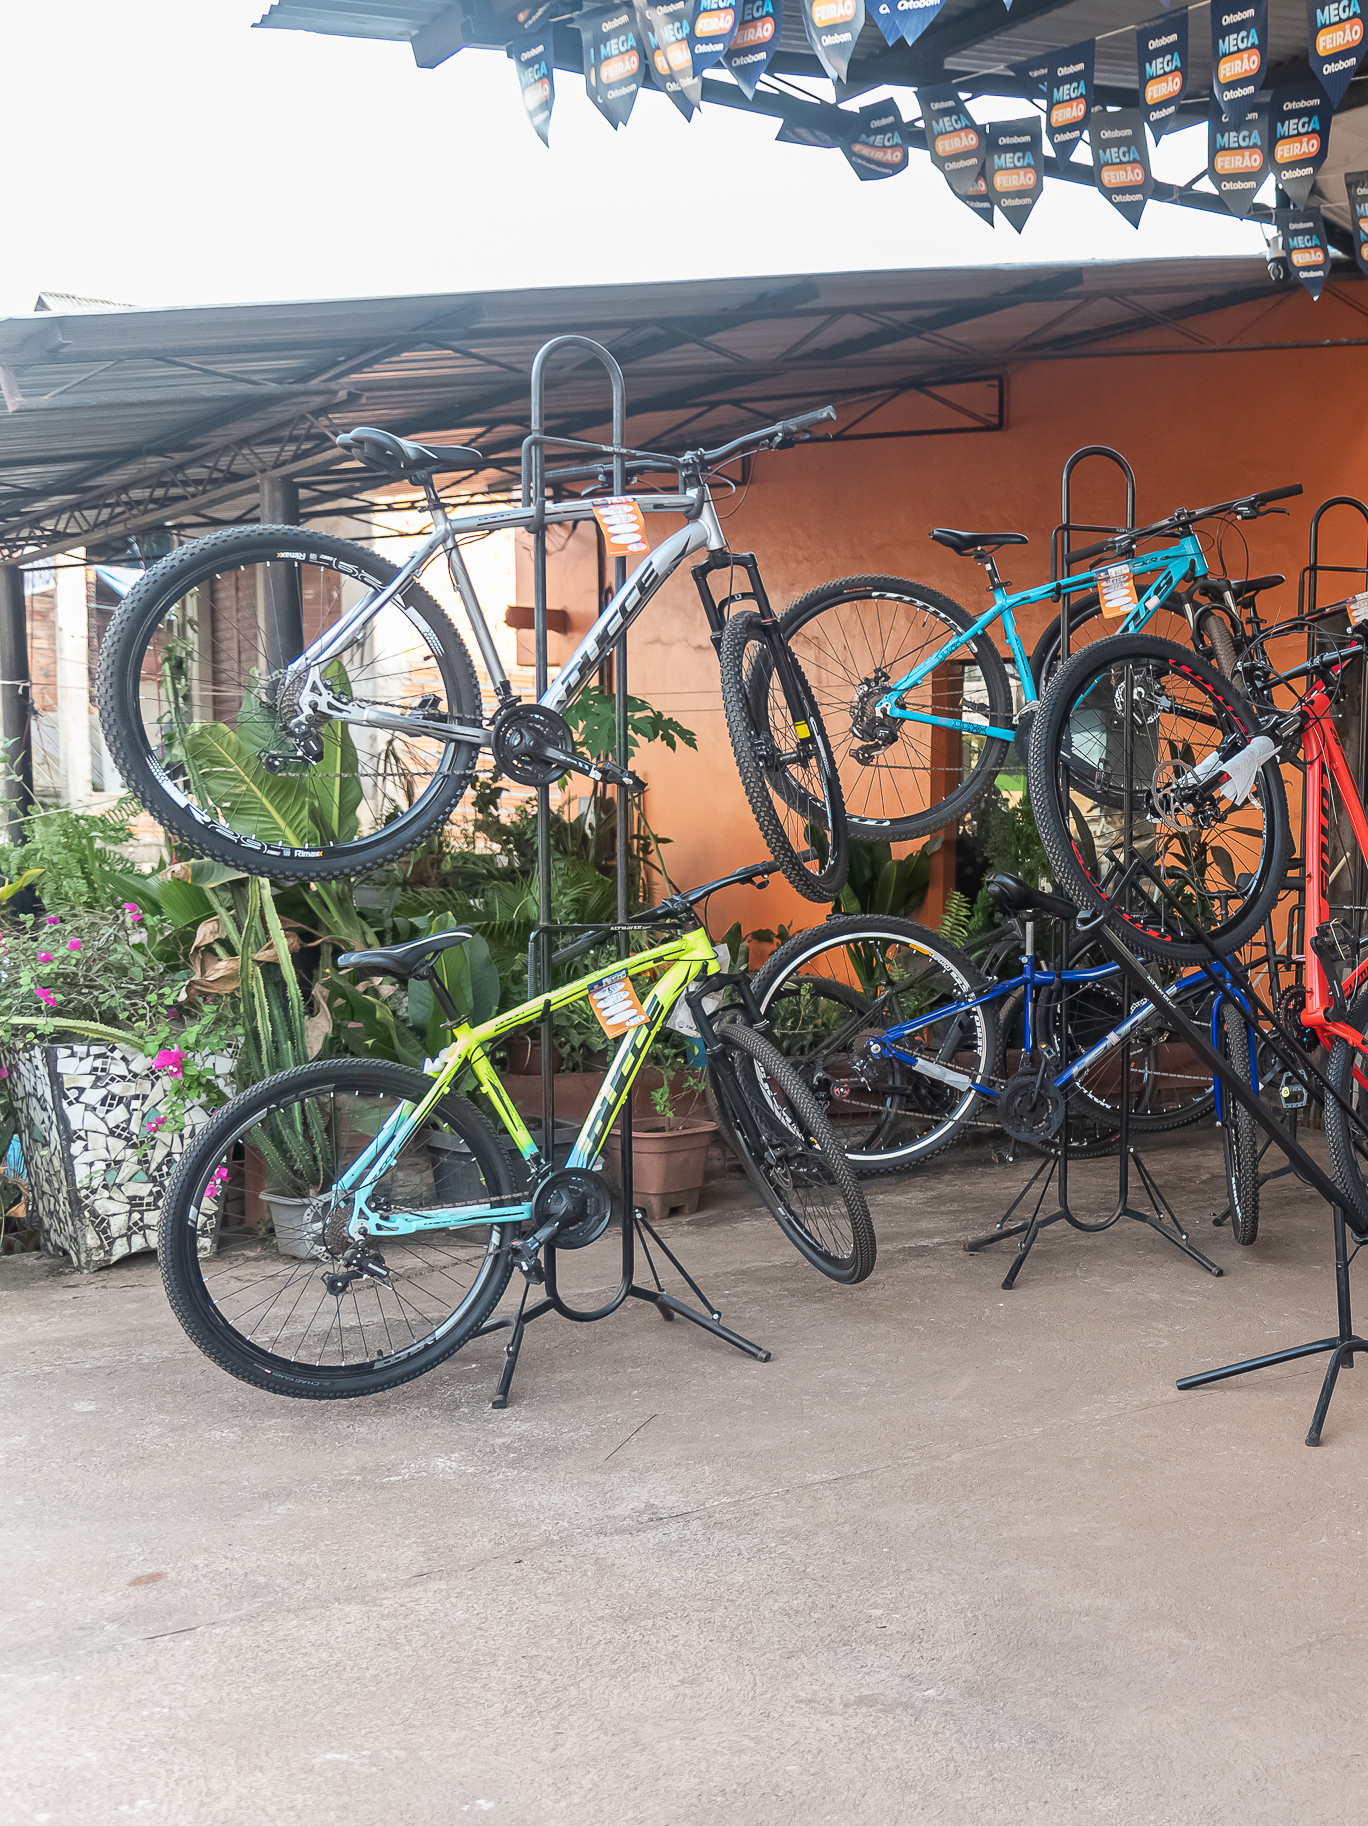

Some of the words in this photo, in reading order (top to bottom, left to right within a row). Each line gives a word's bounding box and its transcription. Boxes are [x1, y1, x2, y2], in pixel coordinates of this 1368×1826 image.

[743, 0, 774, 20] EGA
[1221, 8, 1255, 26] Ortobom
[1316, 0, 1361, 28] MEGA
[601, 14, 630, 33] Ortobom
[697, 12, 733, 33] FEIRÃO
[660, 19, 690, 45] MEGA
[736, 22, 772, 44] EIRÃO
[821, 31, 852, 47] Ortobom
[1318, 22, 1362, 52] FEIRÃO
[600, 32, 637, 60] MEGA
[694, 43, 724, 54] Ortobom
[1148, 33, 1178, 50] Ortobom
[1218, 28, 1259, 56] MEGA
[602, 54, 638, 81] FEIRÃO
[731, 51, 767, 67] Ortobom
[1145, 52, 1181, 79] MEGA
[1219, 54, 1259, 79] FEIRÃO
[1322, 57, 1357, 76] Ortobom
[1057, 63, 1085, 77] Ortobom
[607, 83, 637, 100] Ortobom
[1053, 80, 1086, 103] MEGA
[1147, 74, 1181, 101] FEIRÃO
[1222, 85, 1255, 101] Ortobom
[1052, 102, 1085, 124] FEIRÃO
[1149, 105, 1176, 122] Ortobom
[1283, 98, 1320, 111] Ortobom
[870, 115, 895, 129] Ortobom
[932, 113, 971, 135] MEGA
[1276, 115, 1320, 138] MEGA
[938, 131, 977, 154] FEIRÃO
[998, 135, 1031, 146] Ortobom
[1053, 130, 1081, 143] Ortobom
[1100, 128, 1133, 140] Ortobom
[1216, 130, 1262, 149] MEGA
[854, 145, 903, 163] FEIRÃO
[1099, 146, 1140, 165] MEGA
[1277, 135, 1319, 159] FEIRÃO
[944, 157, 978, 171] Ortobom
[993, 151, 1035, 169] MEGA
[1217, 151, 1261, 170] FEIRÃO
[996, 170, 1035, 188] FEIRÃO
[1103, 166, 1143, 184] FEIRÃO
[1280, 166, 1314, 181] Ortobom
[1221, 180, 1256, 191] Ortobom
[1000, 196, 1032, 207] Ortobom
[1111, 193, 1144, 203] Ortobom
[1289, 234, 1321, 249] MEGA
[1292, 249, 1324, 264] FEIRÃO
[1299, 270, 1324, 279] Ortobom
